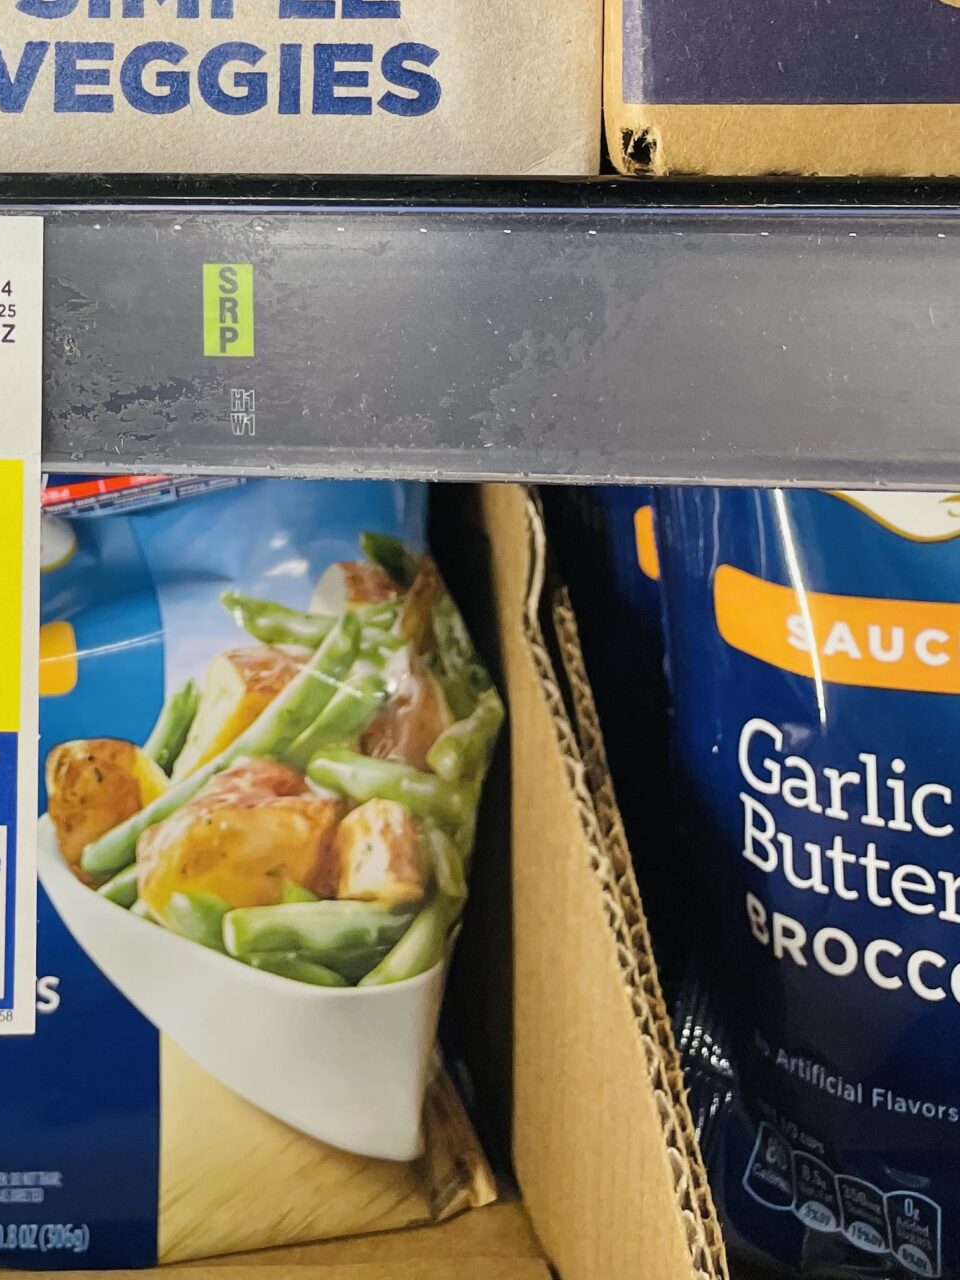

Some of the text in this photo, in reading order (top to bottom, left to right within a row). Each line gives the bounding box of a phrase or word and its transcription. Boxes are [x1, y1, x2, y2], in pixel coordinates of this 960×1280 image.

[785, 613, 960, 667] SAUC
[738, 717, 955, 838] Garlic
[745, 891, 960, 1004] BROCC
[775, 1047, 863, 1105] Artificial
